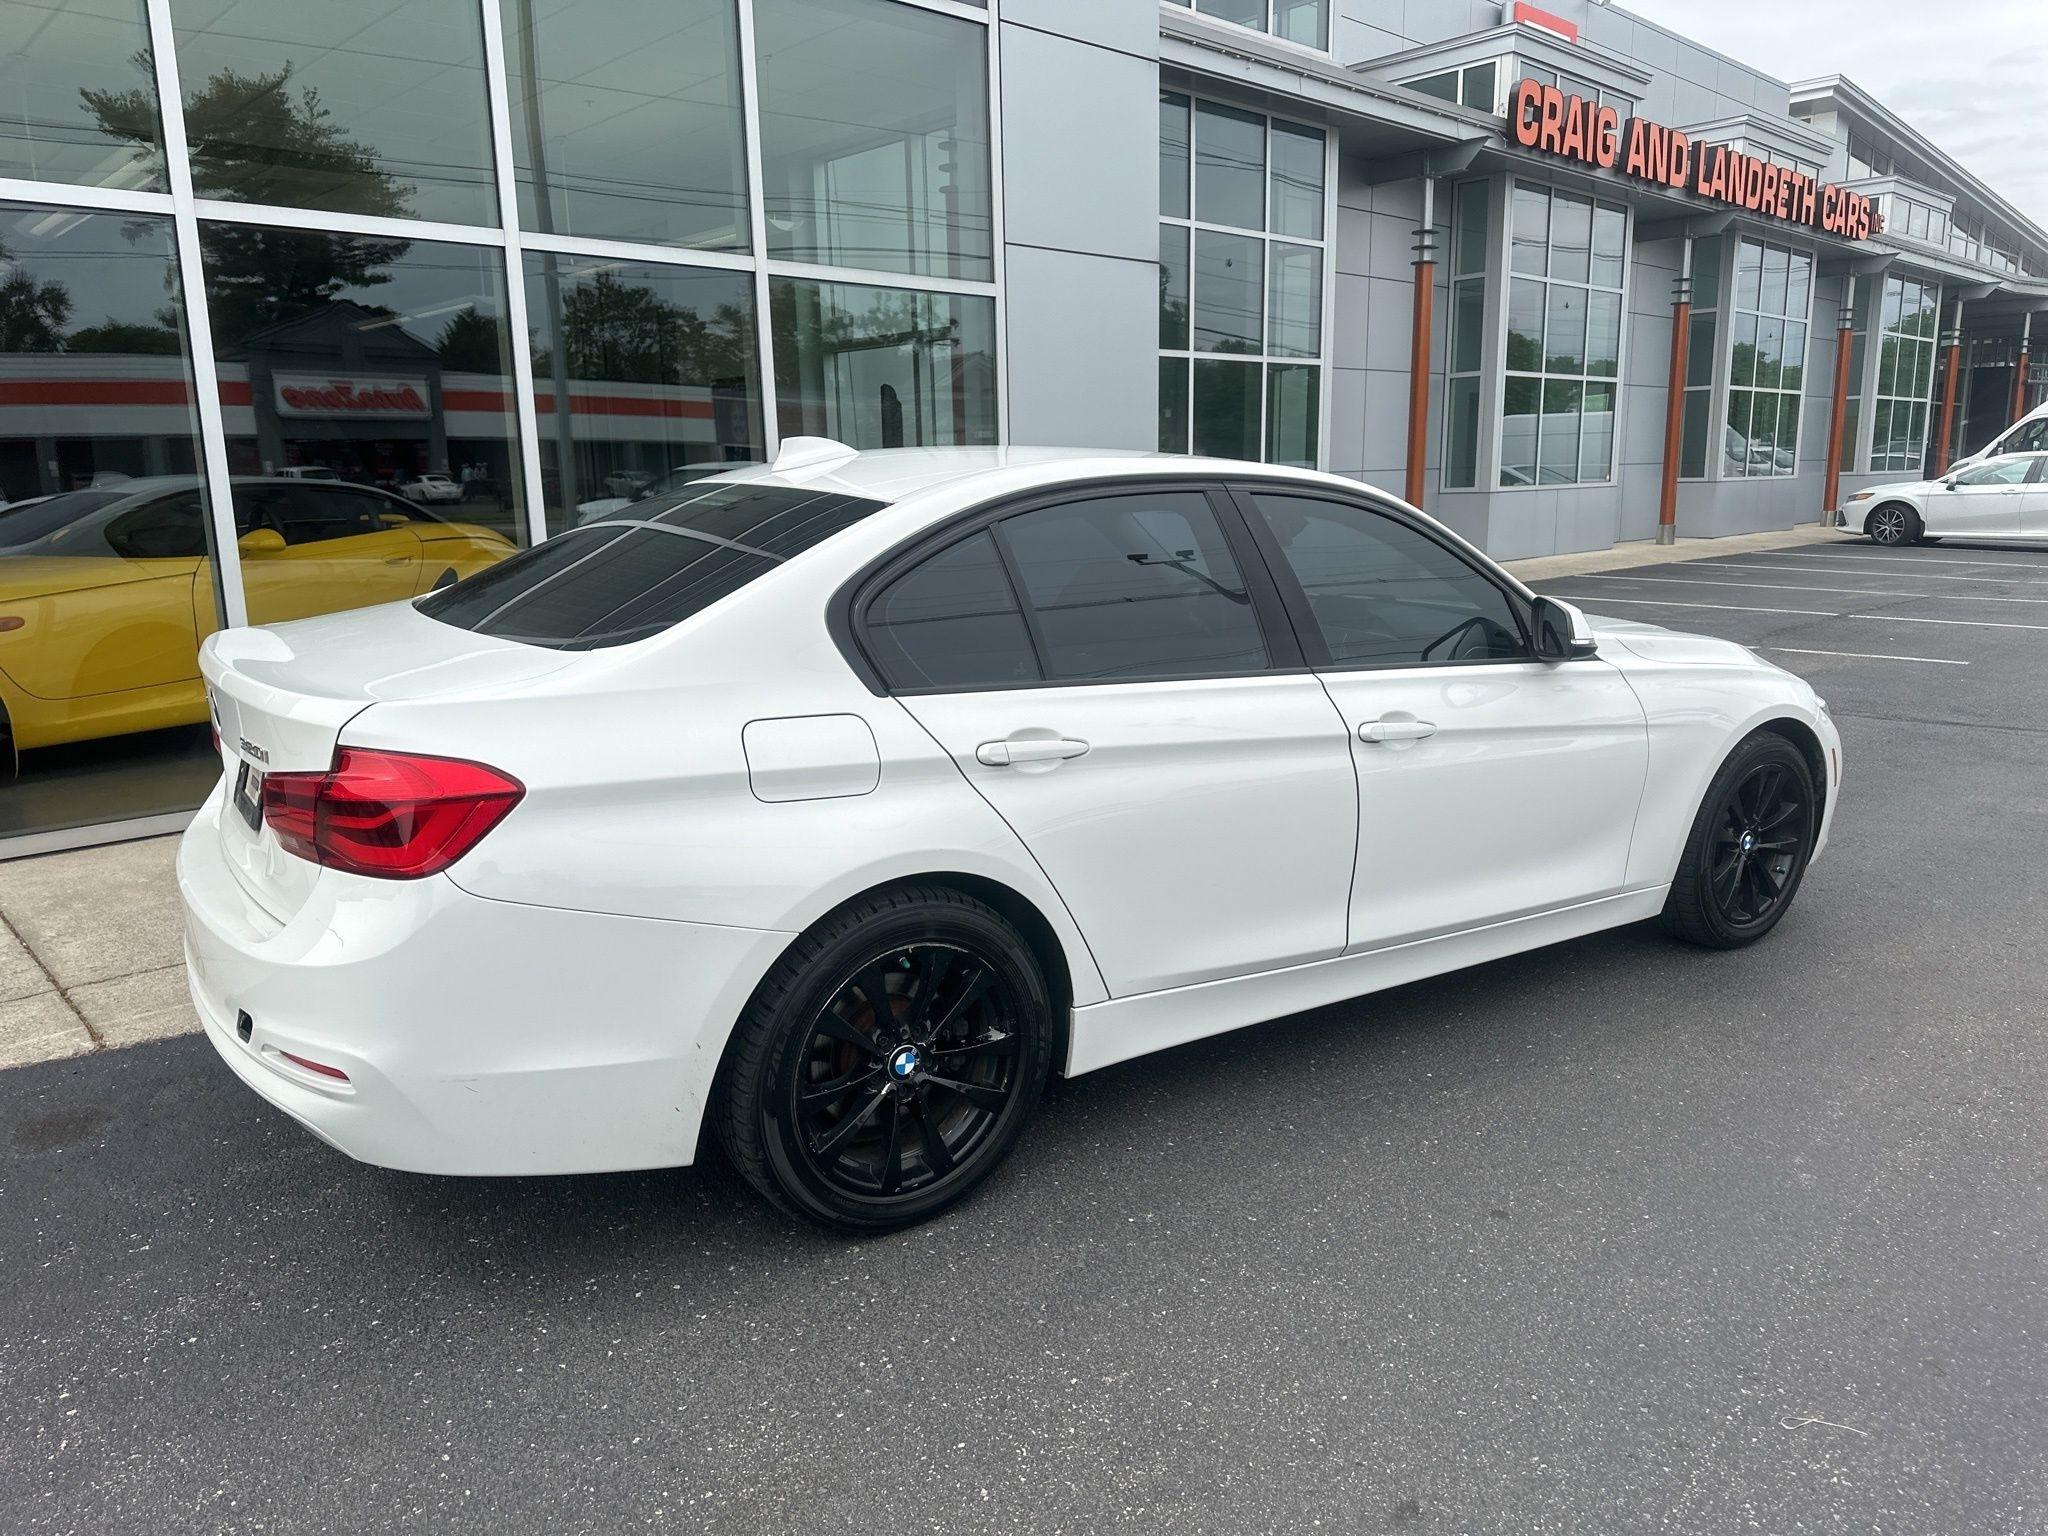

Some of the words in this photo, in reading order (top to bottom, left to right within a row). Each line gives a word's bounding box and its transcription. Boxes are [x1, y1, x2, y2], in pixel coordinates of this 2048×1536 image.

[1514, 77, 1618, 168] CRAIG
[1626, 117, 1689, 188] AND
[1696, 140, 1818, 225] LANDRETH
[1822, 184, 1870, 240] CARS
